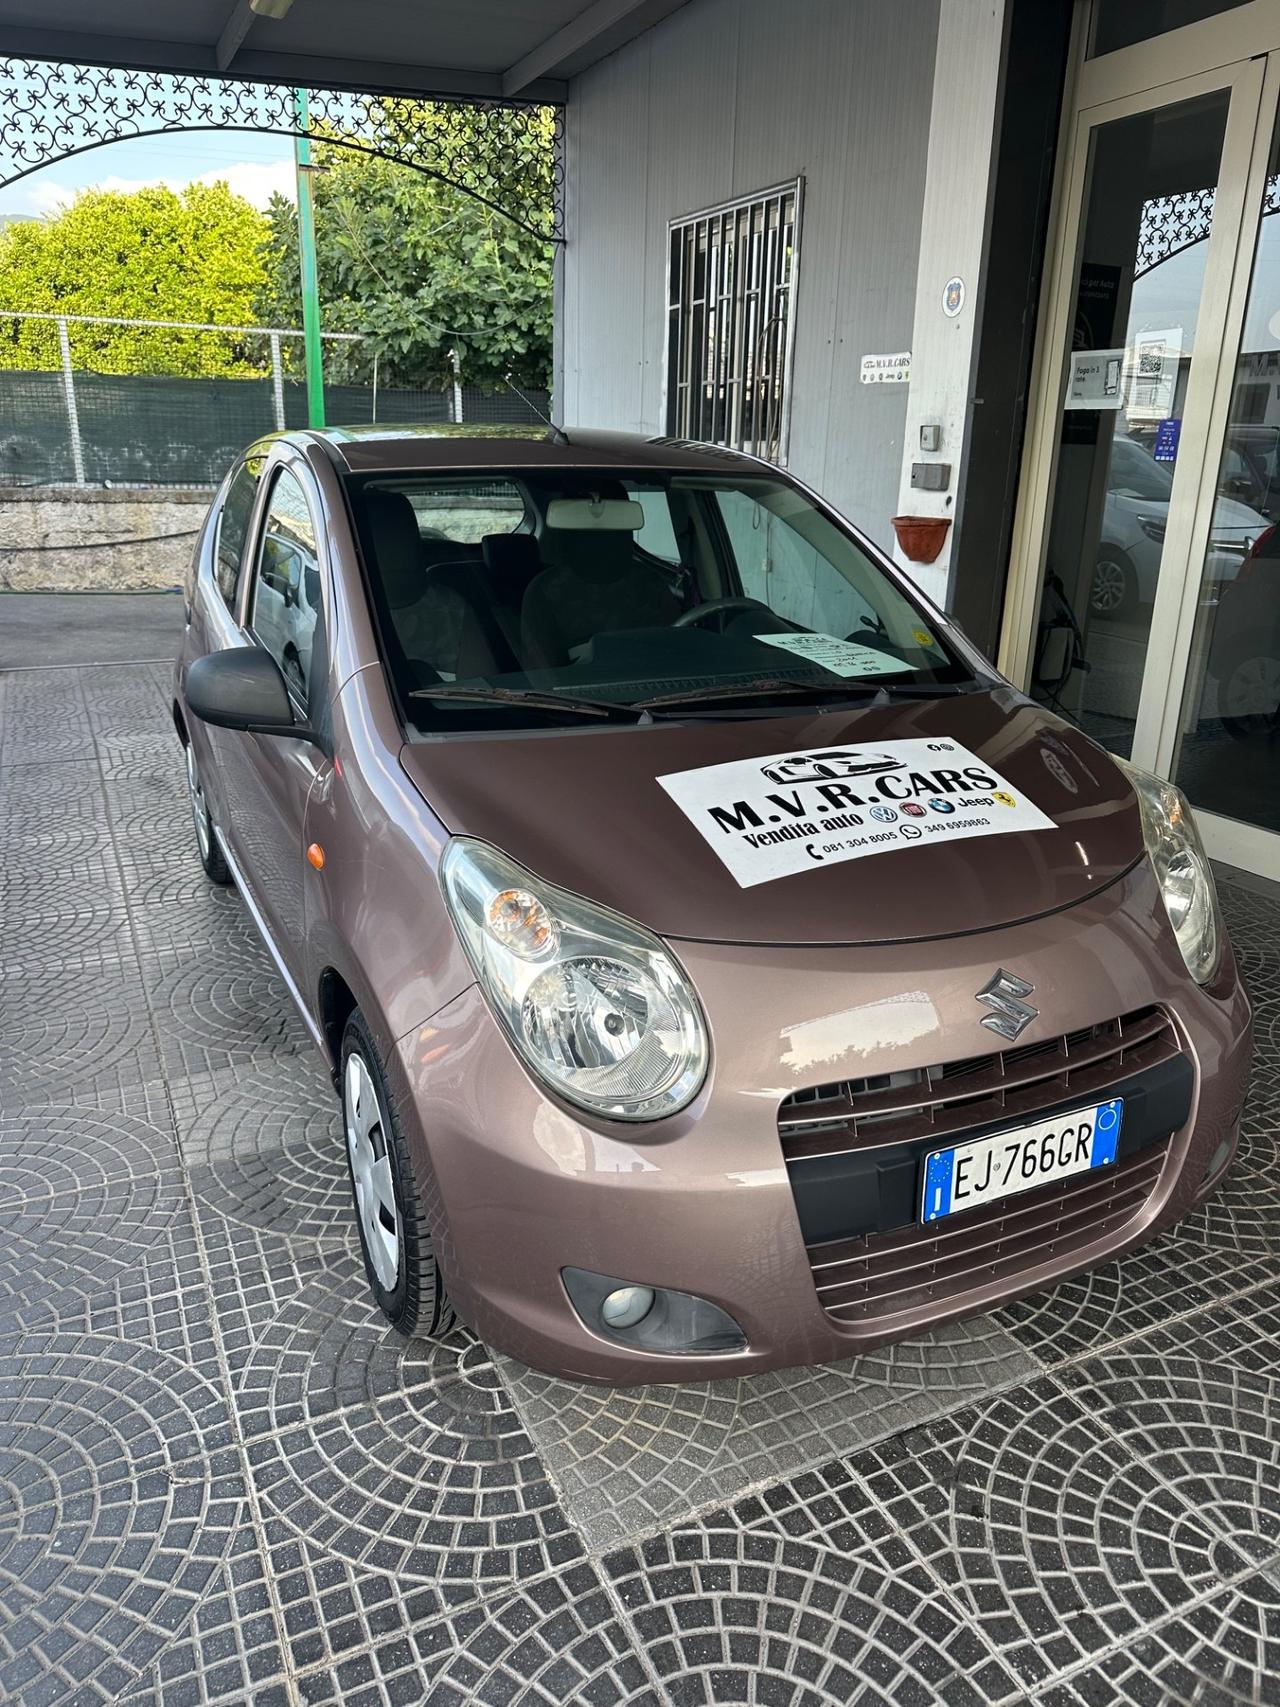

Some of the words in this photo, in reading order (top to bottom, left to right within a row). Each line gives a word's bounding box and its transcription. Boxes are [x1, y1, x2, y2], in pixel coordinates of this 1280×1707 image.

[707, 767, 998, 834] M.V.R.CARS
[957, 797, 995, 807] Jeep
[742, 821, 820, 848] Vendita
[820, 813, 864, 831] auto
[924, 823, 946, 833] 349
[822, 842, 845, 853] 081
[846, 837, 868, 848] 304
[868, 831, 898, 843] 8005
